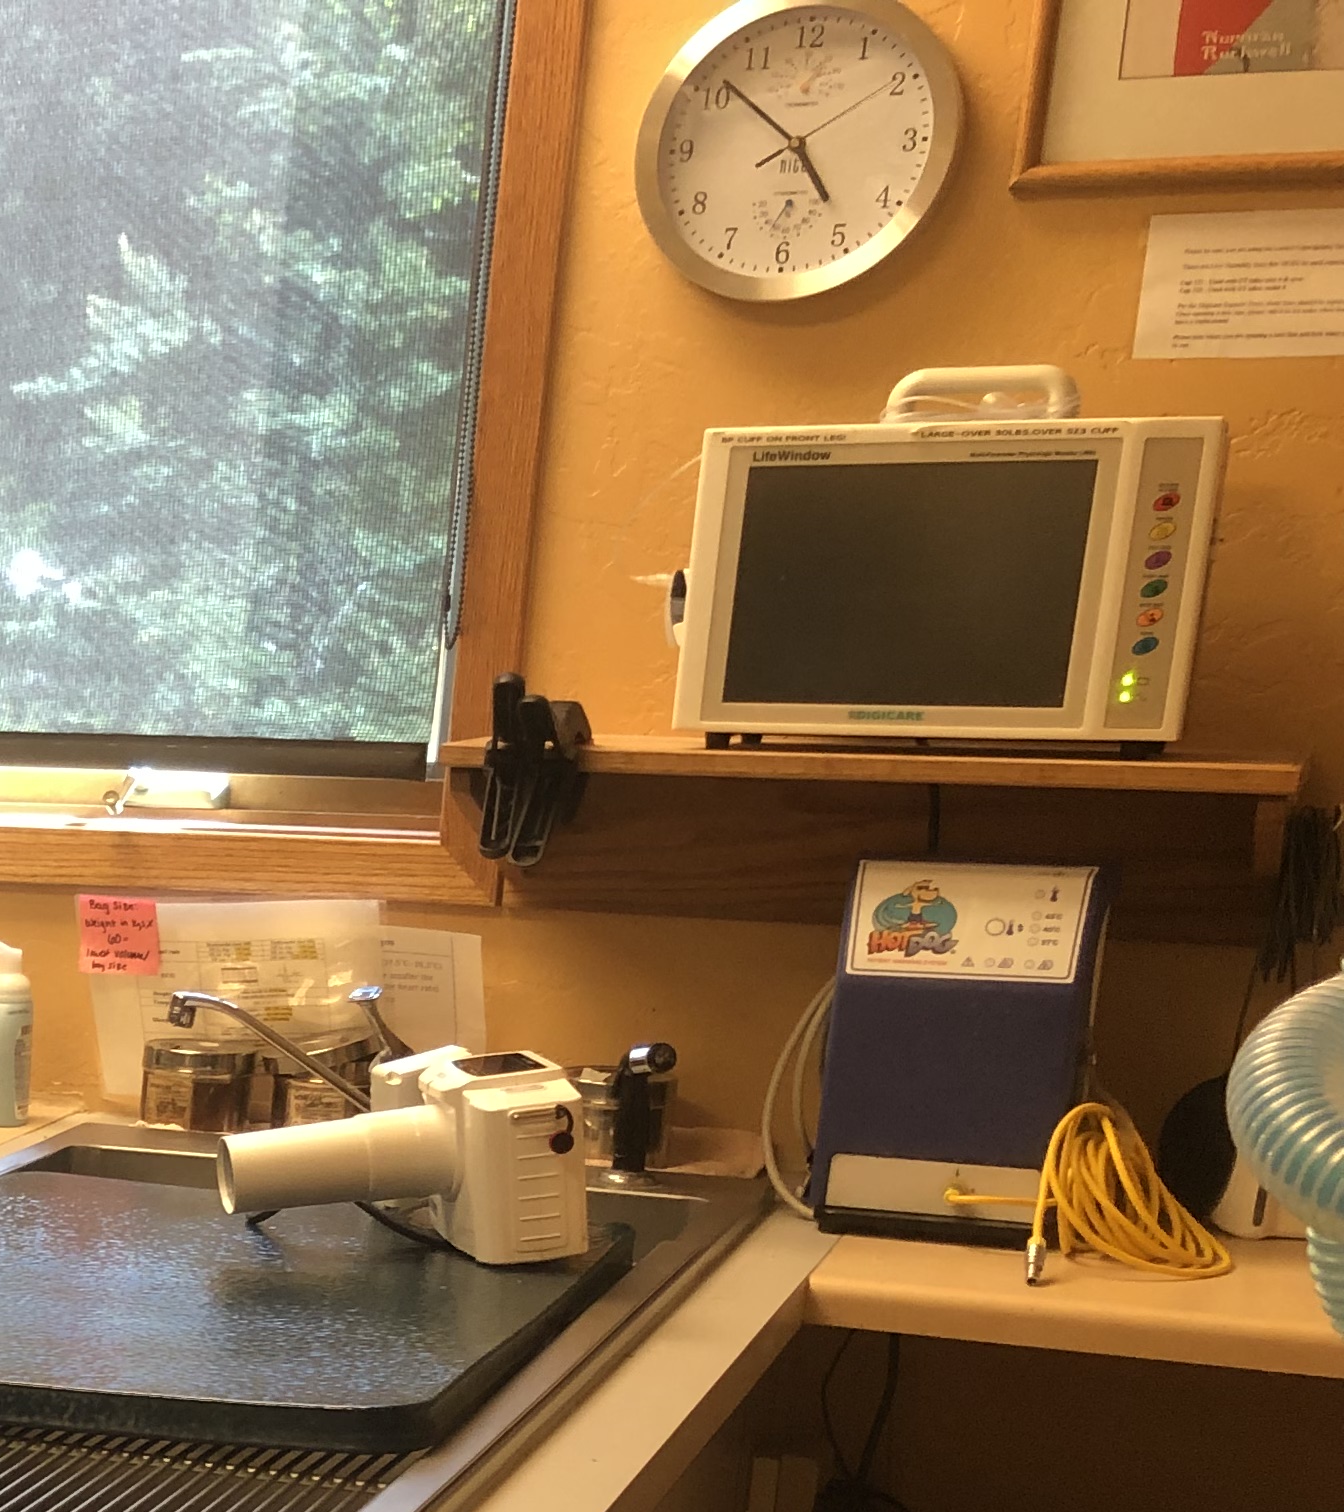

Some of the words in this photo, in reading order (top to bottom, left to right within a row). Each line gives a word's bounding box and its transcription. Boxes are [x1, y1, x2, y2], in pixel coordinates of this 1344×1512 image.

[796, 26, 824, 49] 12
[858, 36, 870, 60] 1
[745, 46, 771, 71] 11
[889, 72, 906, 96] 2
[702, 86, 731, 111] 10
[679, 139, 694, 163] 9
[902, 128, 918, 152] 3
[691, 192, 708, 215] 8
[875, 186, 891, 209] 4
[723, 226, 739, 250] 7
[830, 223, 847, 247] 5
[775, 241, 790, 265] 6
[752, 449, 831, 463] LifeWindow
